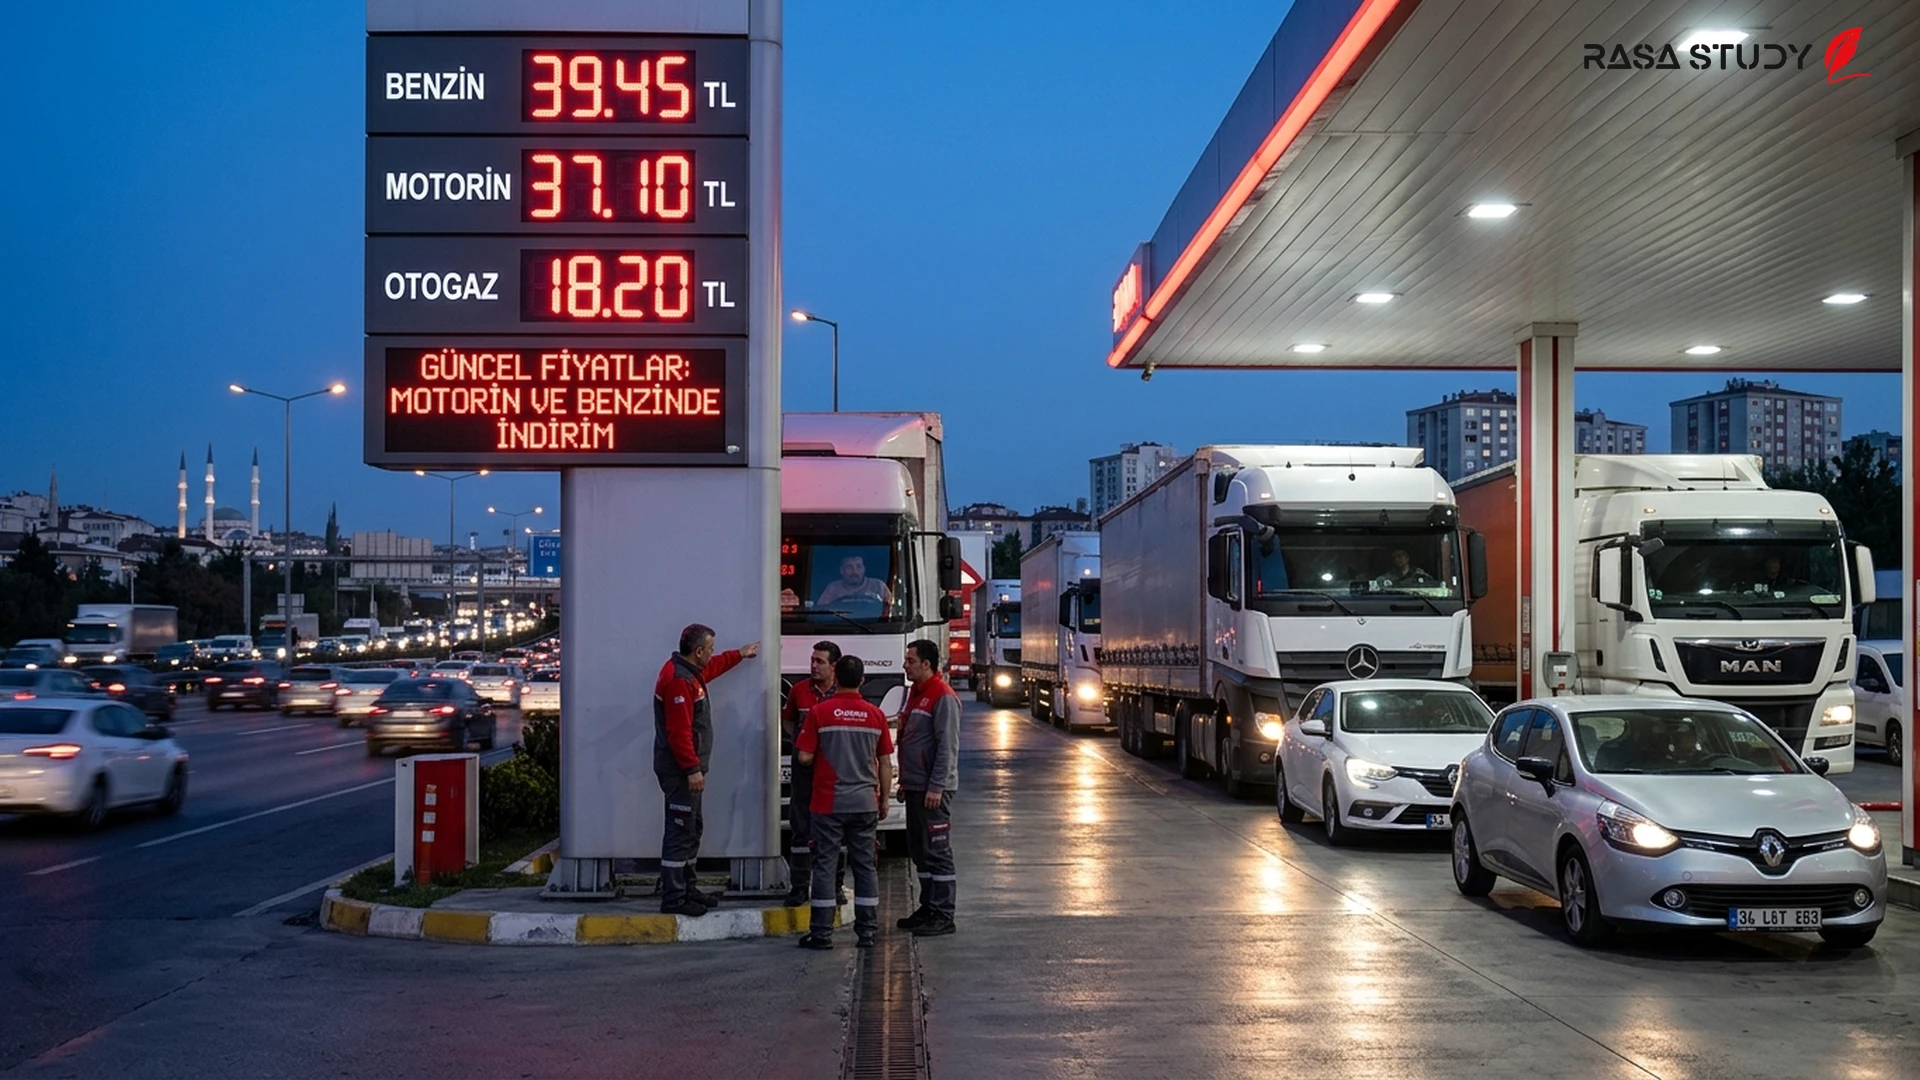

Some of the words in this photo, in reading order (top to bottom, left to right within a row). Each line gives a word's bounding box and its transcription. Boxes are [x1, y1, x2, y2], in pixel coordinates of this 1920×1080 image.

[386, 66, 485, 100] BENZİN
[532, 55, 690, 118] 39.45
[703, 81, 736, 108] TL
[386, 167, 511, 200] MOTORİN
[531, 155, 690, 218] 37.10
[703, 181, 736, 207] TL
[384, 272, 499, 301] OTOGAZ
[551, 256, 689, 318] 18.20
[702, 281, 736, 307] TL
[421, 349, 532, 381] GÜNCEL
[541, 349, 690, 381] FİYATLAR:
[391, 382, 521, 415] MOTORİN
[531, 388, 568, 415] VE
[578, 383, 721, 415] BENZİNDE
[497, 417, 614, 450] İNDİRİM
[1720, 660, 1782, 673] MAN
